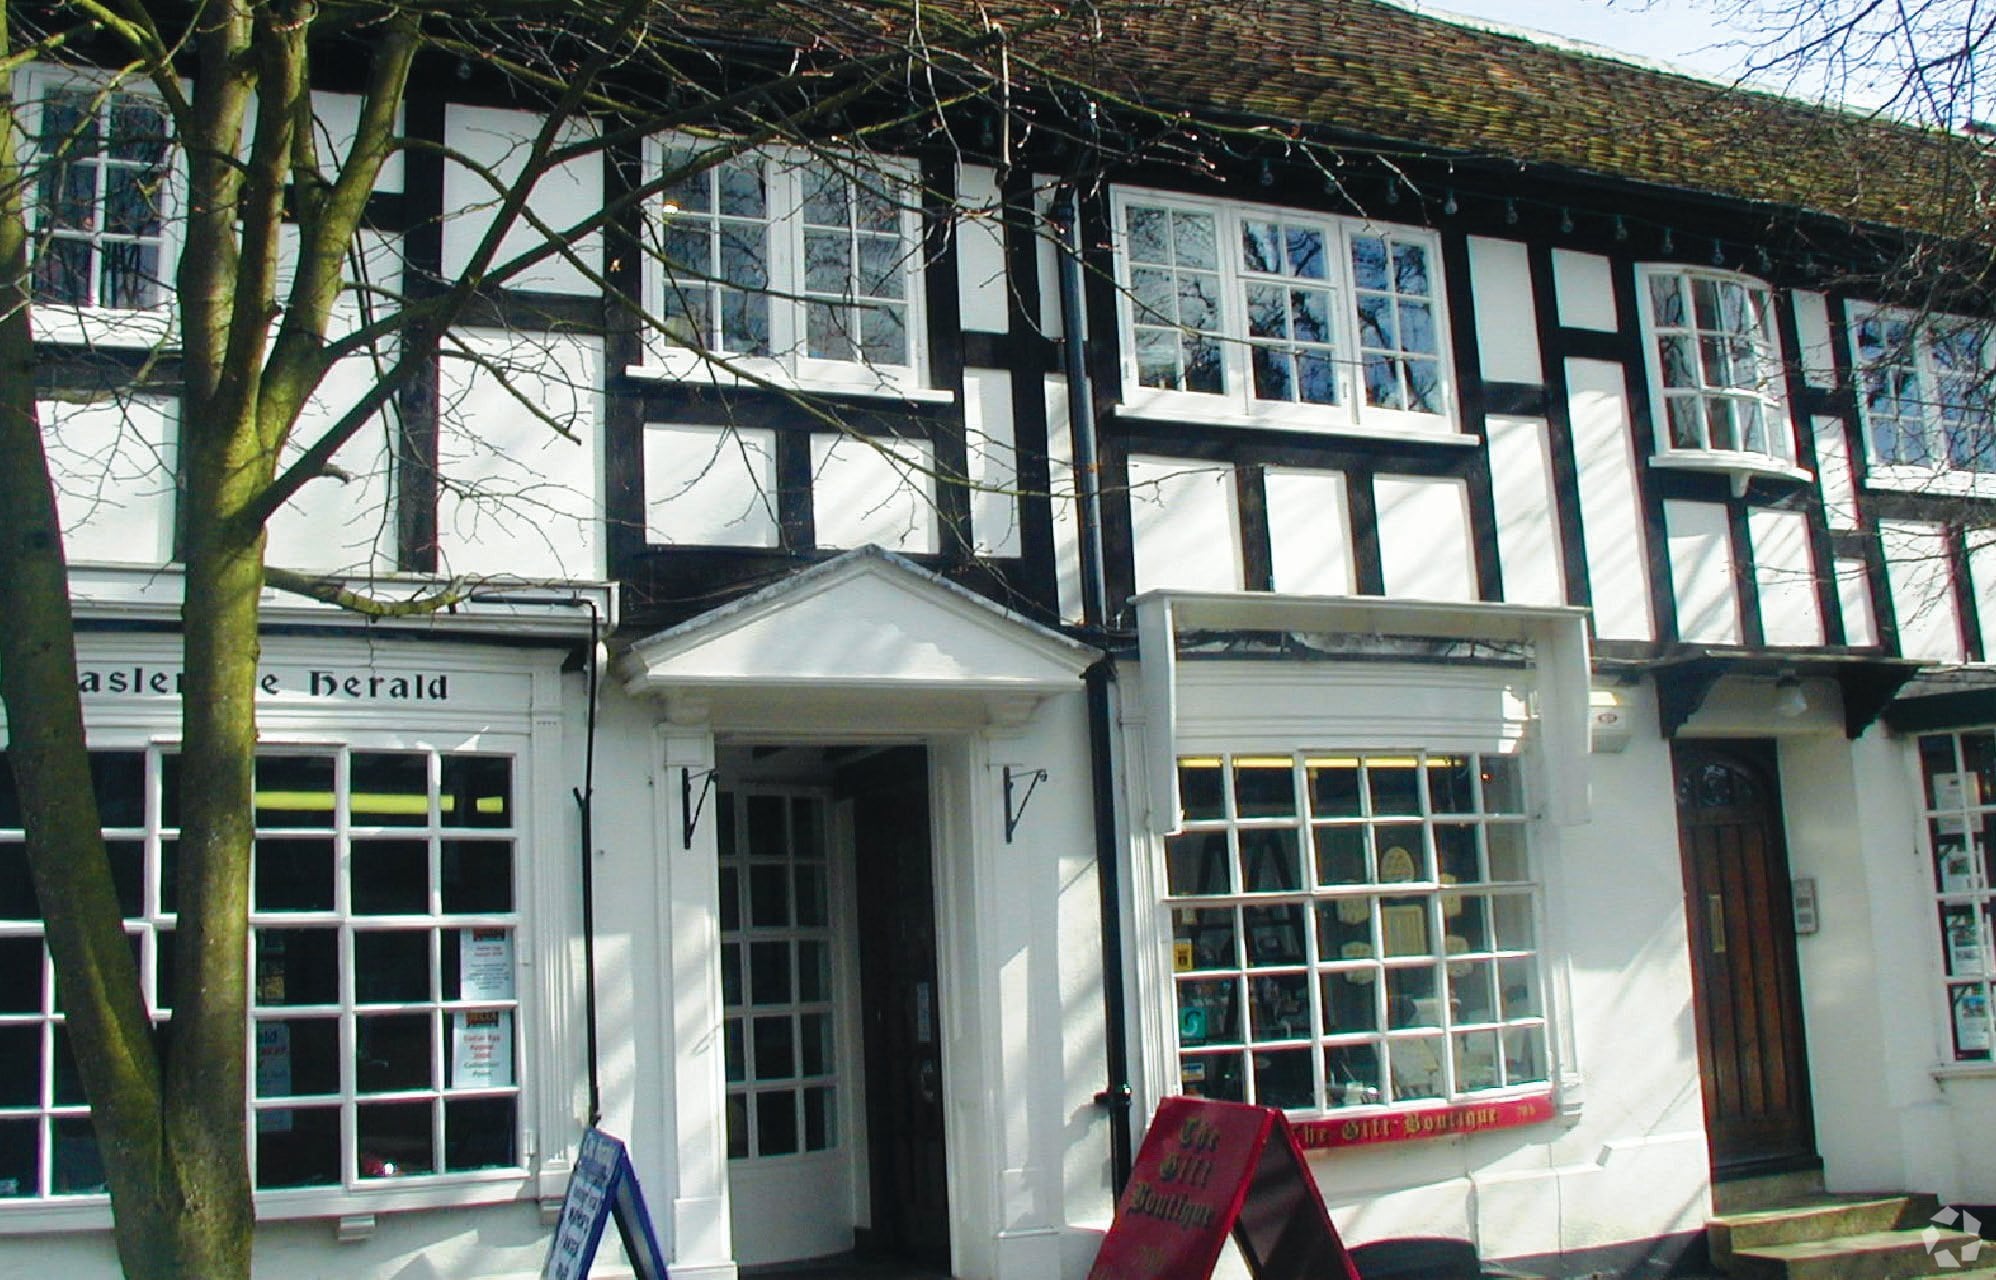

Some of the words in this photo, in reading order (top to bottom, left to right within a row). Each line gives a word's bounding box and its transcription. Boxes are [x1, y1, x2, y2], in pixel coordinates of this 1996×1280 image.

[1180, 1117, 1220, 1151] The
[1342, 1117, 1391, 1141] Gift
[1404, 1107, 1498, 1134] Boutique
[1160, 1152, 1212, 1189] Gift
[1127, 1181, 1215, 1230] Boutique
